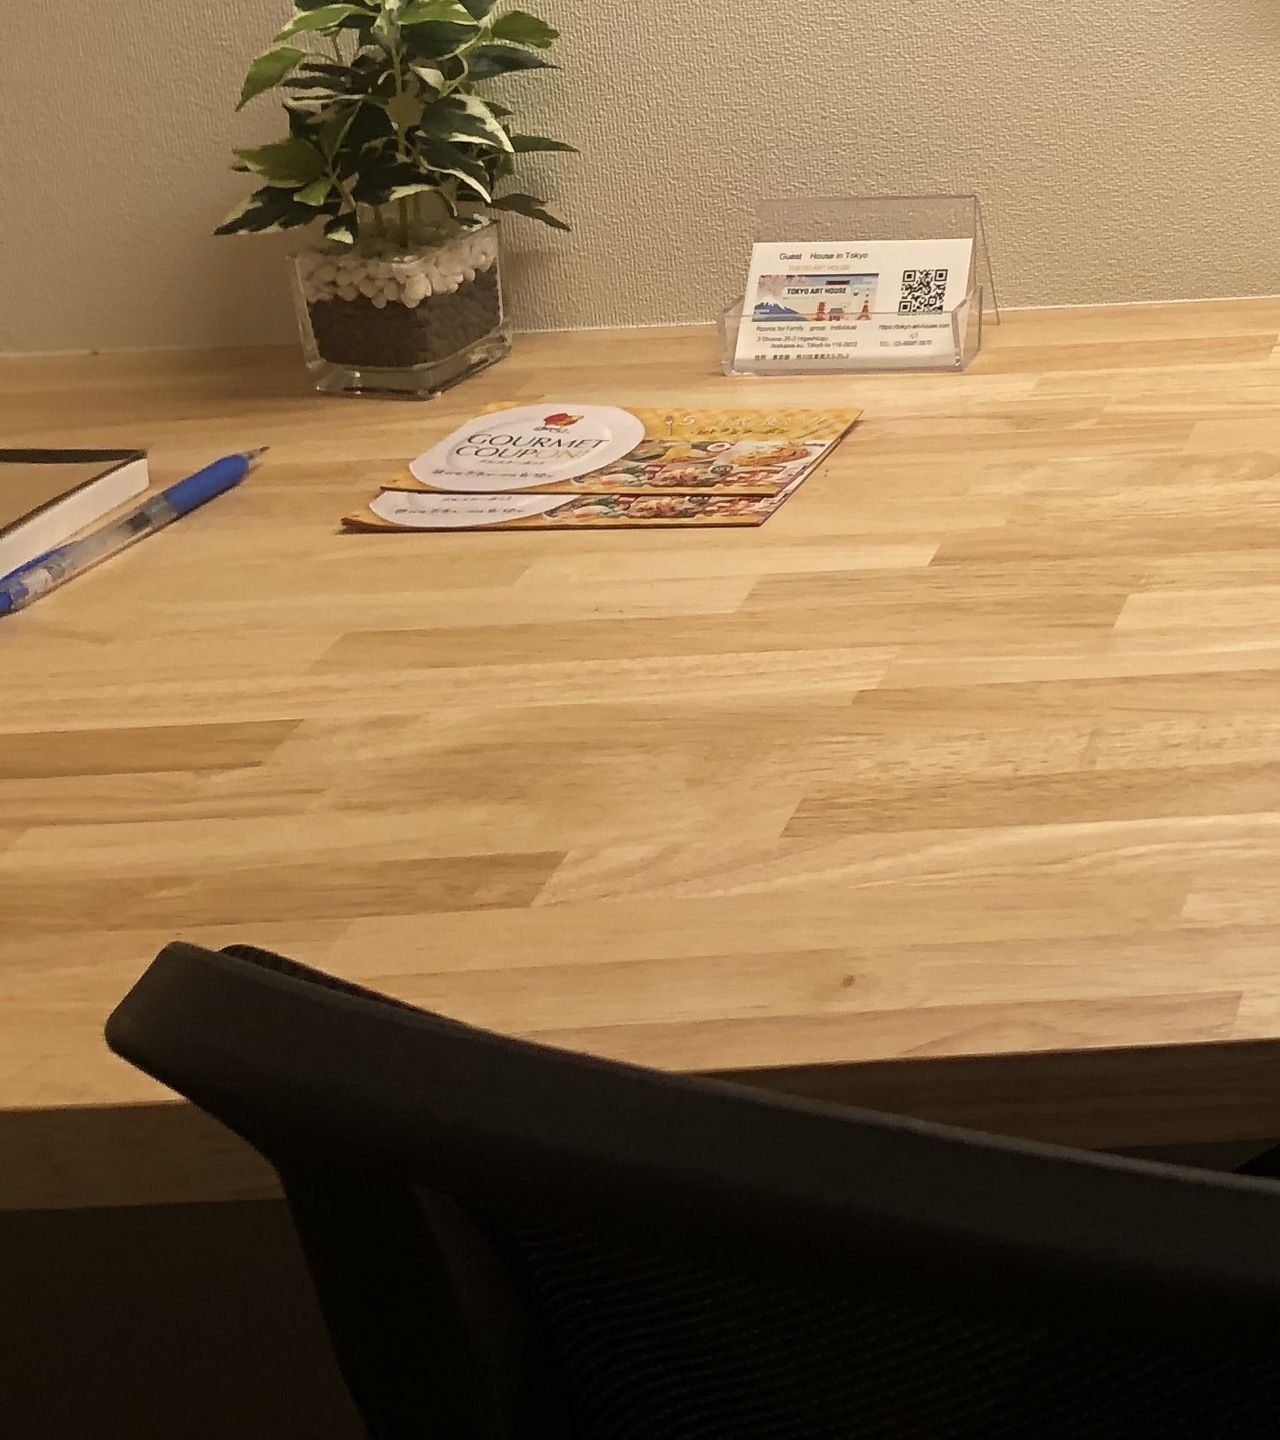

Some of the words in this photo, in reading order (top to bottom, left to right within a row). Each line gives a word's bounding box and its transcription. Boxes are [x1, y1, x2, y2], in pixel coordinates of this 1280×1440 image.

[779, 252, 803, 261] Guest
[810, 251, 834, 260] House
[844, 251, 868, 261] Tokyo
[786, 287, 809, 296] TOKYO
[810, 287, 824, 295] ART
[467, 433, 611, 450] GOURMET
[456, 445, 589, 459] COUPON
